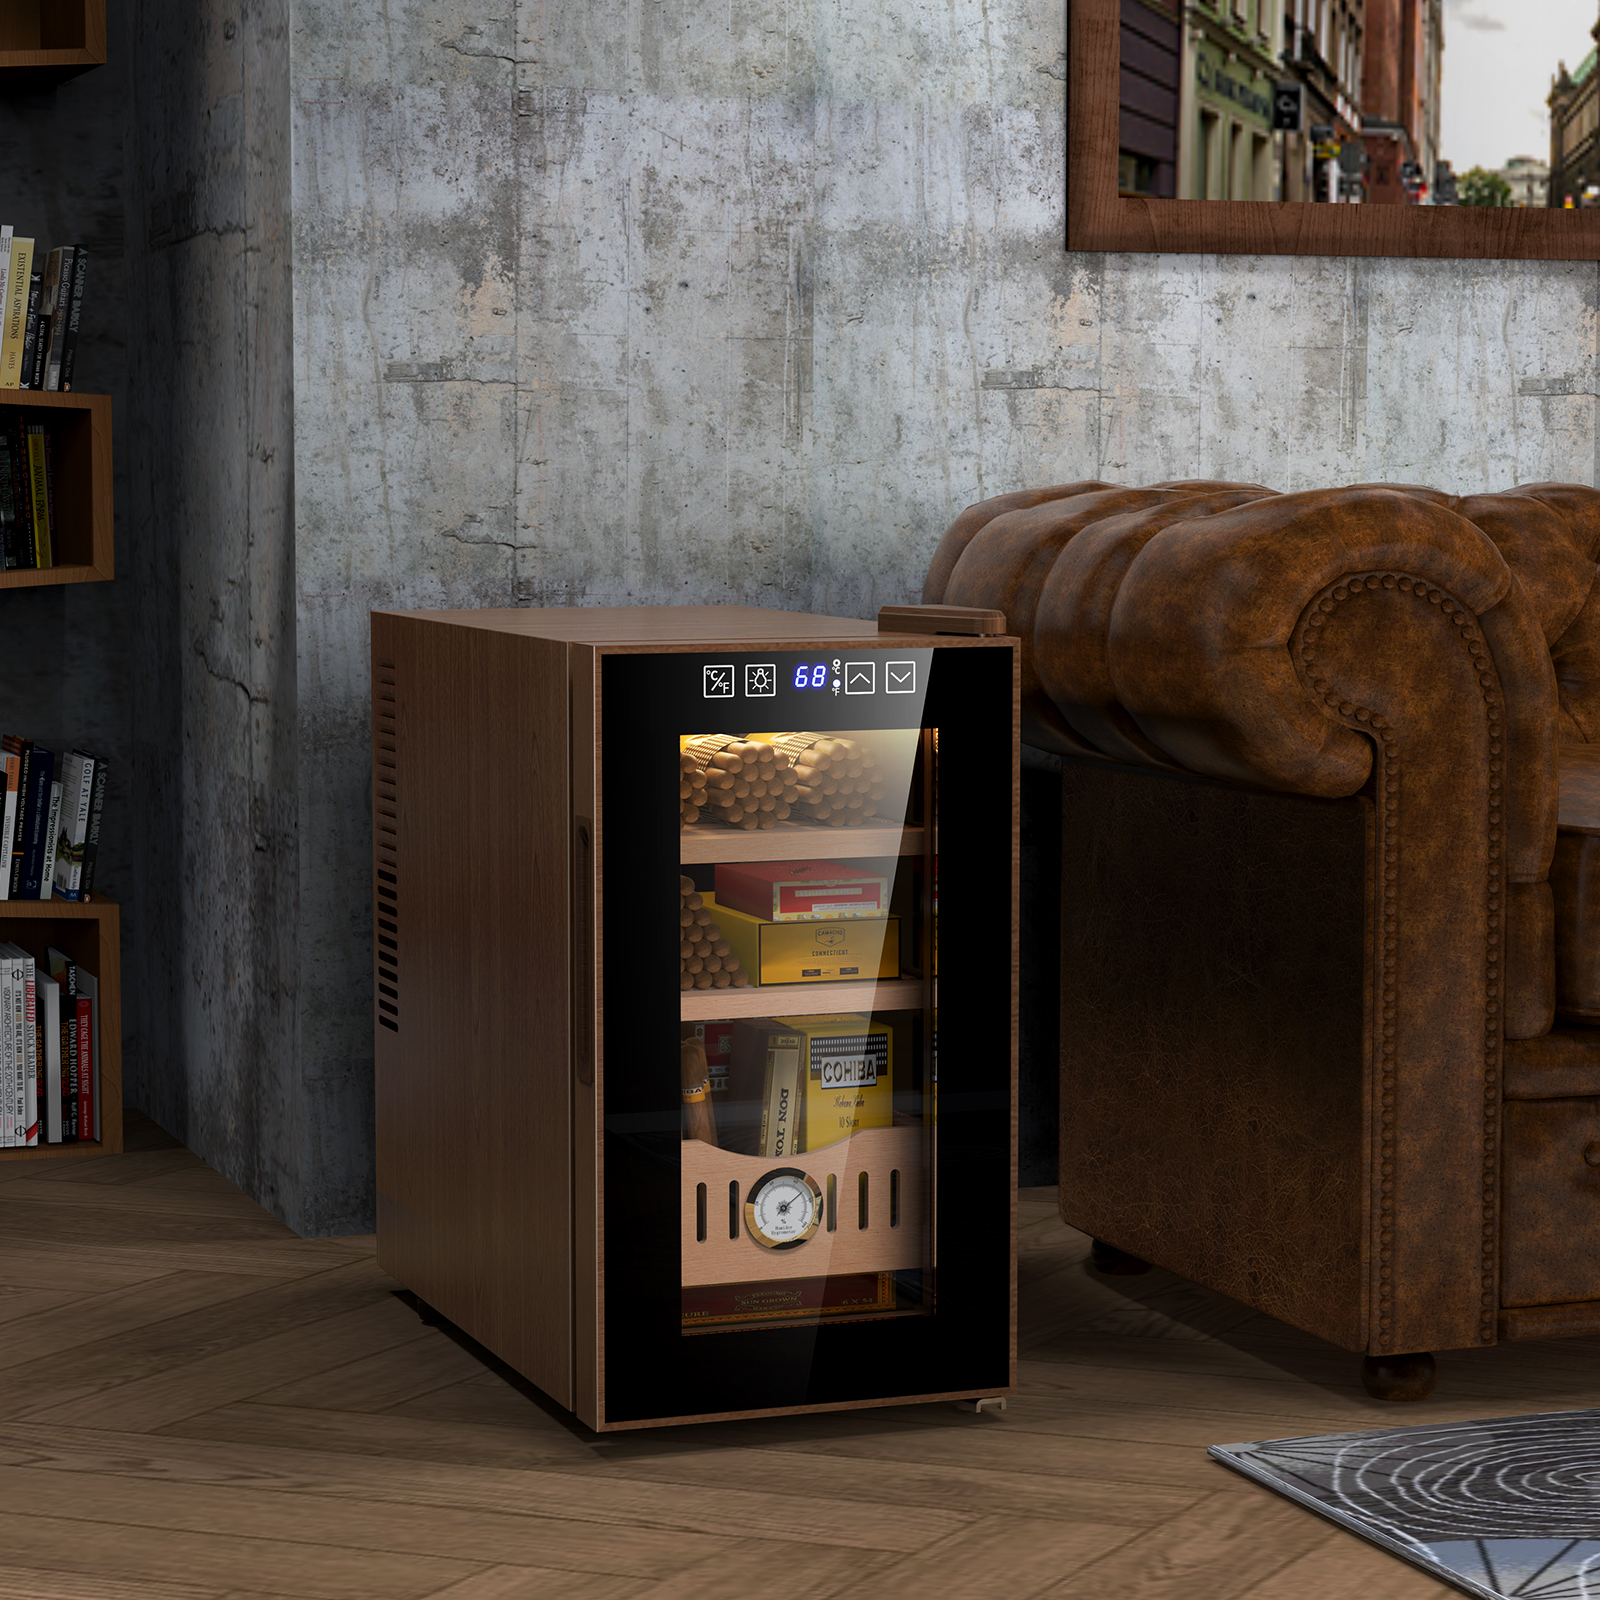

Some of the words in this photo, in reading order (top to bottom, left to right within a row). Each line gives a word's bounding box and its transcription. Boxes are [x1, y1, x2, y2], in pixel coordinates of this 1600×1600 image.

[15, 253, 26, 295] EXISTENTIAL
[62, 258, 73, 281] Picasso
[74, 258, 87, 297] SCANNER
[59, 282, 70, 306] Guitars
[11, 298, 21, 339] ASPIRATIONS
[69, 300, 83, 332] DARKLY
[19, 416, 31, 518] TRAINSPOTTING
[33, 465, 44, 497] ANIMAL
[36, 500, 45, 521] FARM
[794, 665, 826, 688] 68
[83, 763, 92, 784] GOLF
[82, 788, 88, 798] AT
[93, 772, 106, 811] SCANNER
[79, 803, 87, 821] YALE
[46, 809, 58, 854] Impressionists
[89, 814, 101, 845] DARKLY
[25, 980, 35, 1022] LIBERATED
[4, 1013, 13, 1052] ARCHITECTURE
[69, 1019, 77, 1056] EDWARD
[61, 1036, 69, 1077] GATHERING
[823, 1060, 875, 1083] COHIBA
[70, 1059, 78, 1094] HOPPER
[779, 1088, 788, 1122] DON
[839, 1117, 845, 1128] 10
